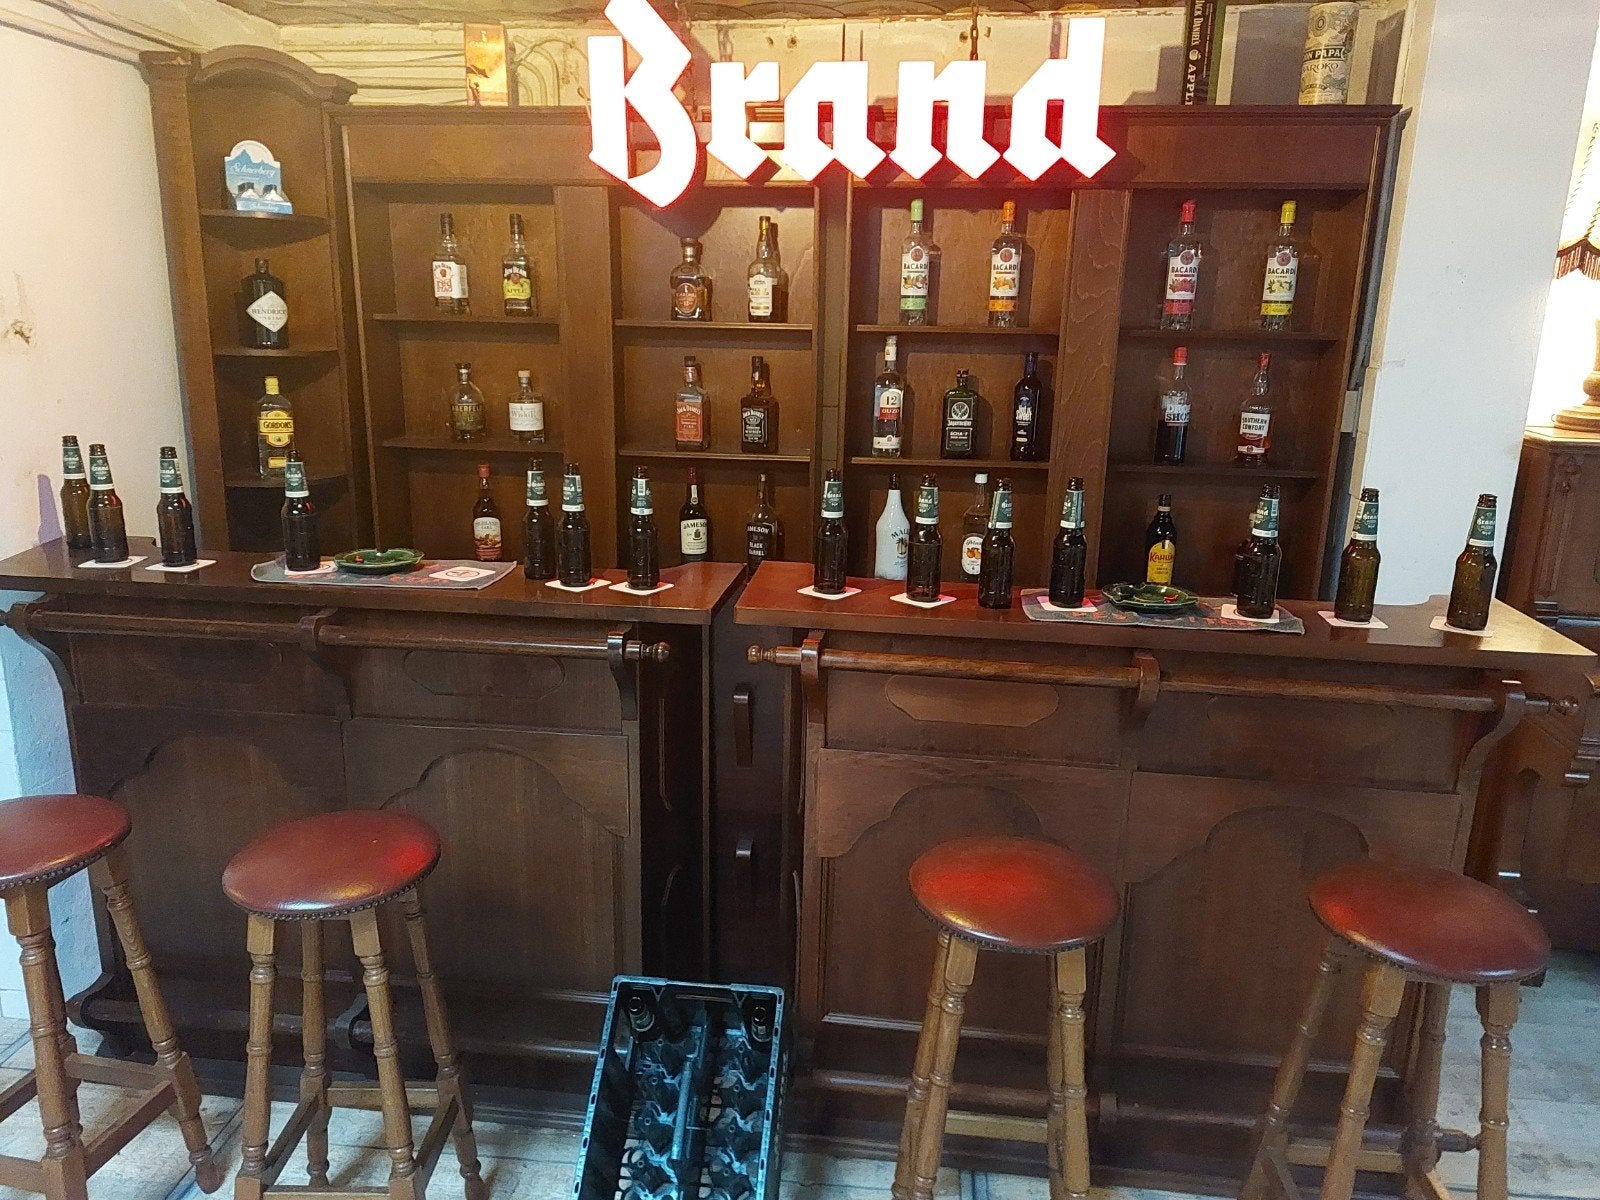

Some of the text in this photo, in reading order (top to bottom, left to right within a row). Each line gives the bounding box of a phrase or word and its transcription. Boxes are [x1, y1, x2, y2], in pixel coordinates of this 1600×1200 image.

[1315, 49, 1341, 59] PAPA
[588, 0, 1116, 208] Brand
[886, 395, 897, 405] 12
[1165, 412, 1189, 422] SHO
[683, 521, 707, 530] JAMESO
